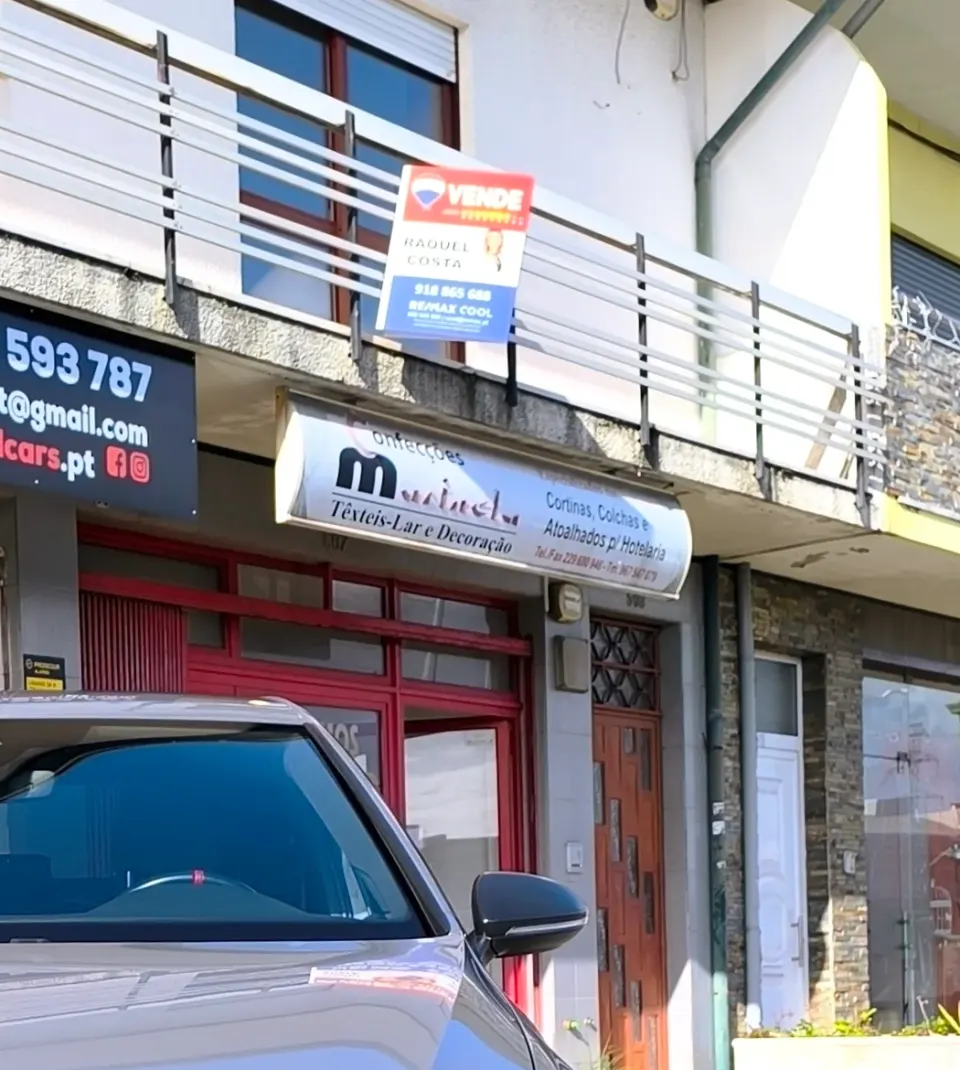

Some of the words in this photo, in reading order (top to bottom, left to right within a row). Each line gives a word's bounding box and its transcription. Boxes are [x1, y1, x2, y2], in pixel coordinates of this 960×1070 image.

[448, 183, 525, 211] VENDE
[407, 255, 461, 268] COSTA
[459, 305, 493, 318] COOL
[6, 326, 80, 385] 593
[87, 348, 152, 402] 787
[331, 499, 423, 535] Têxteis-Lar
[424, 525, 435, 538] e
[436, 523, 513, 555] Decoração
[598, 504, 640, 530] Colchas
[641, 518, 650, 531] e
[543, 518, 607, 548] Atoalhados
[620, 535, 667, 562] Hotelaria
